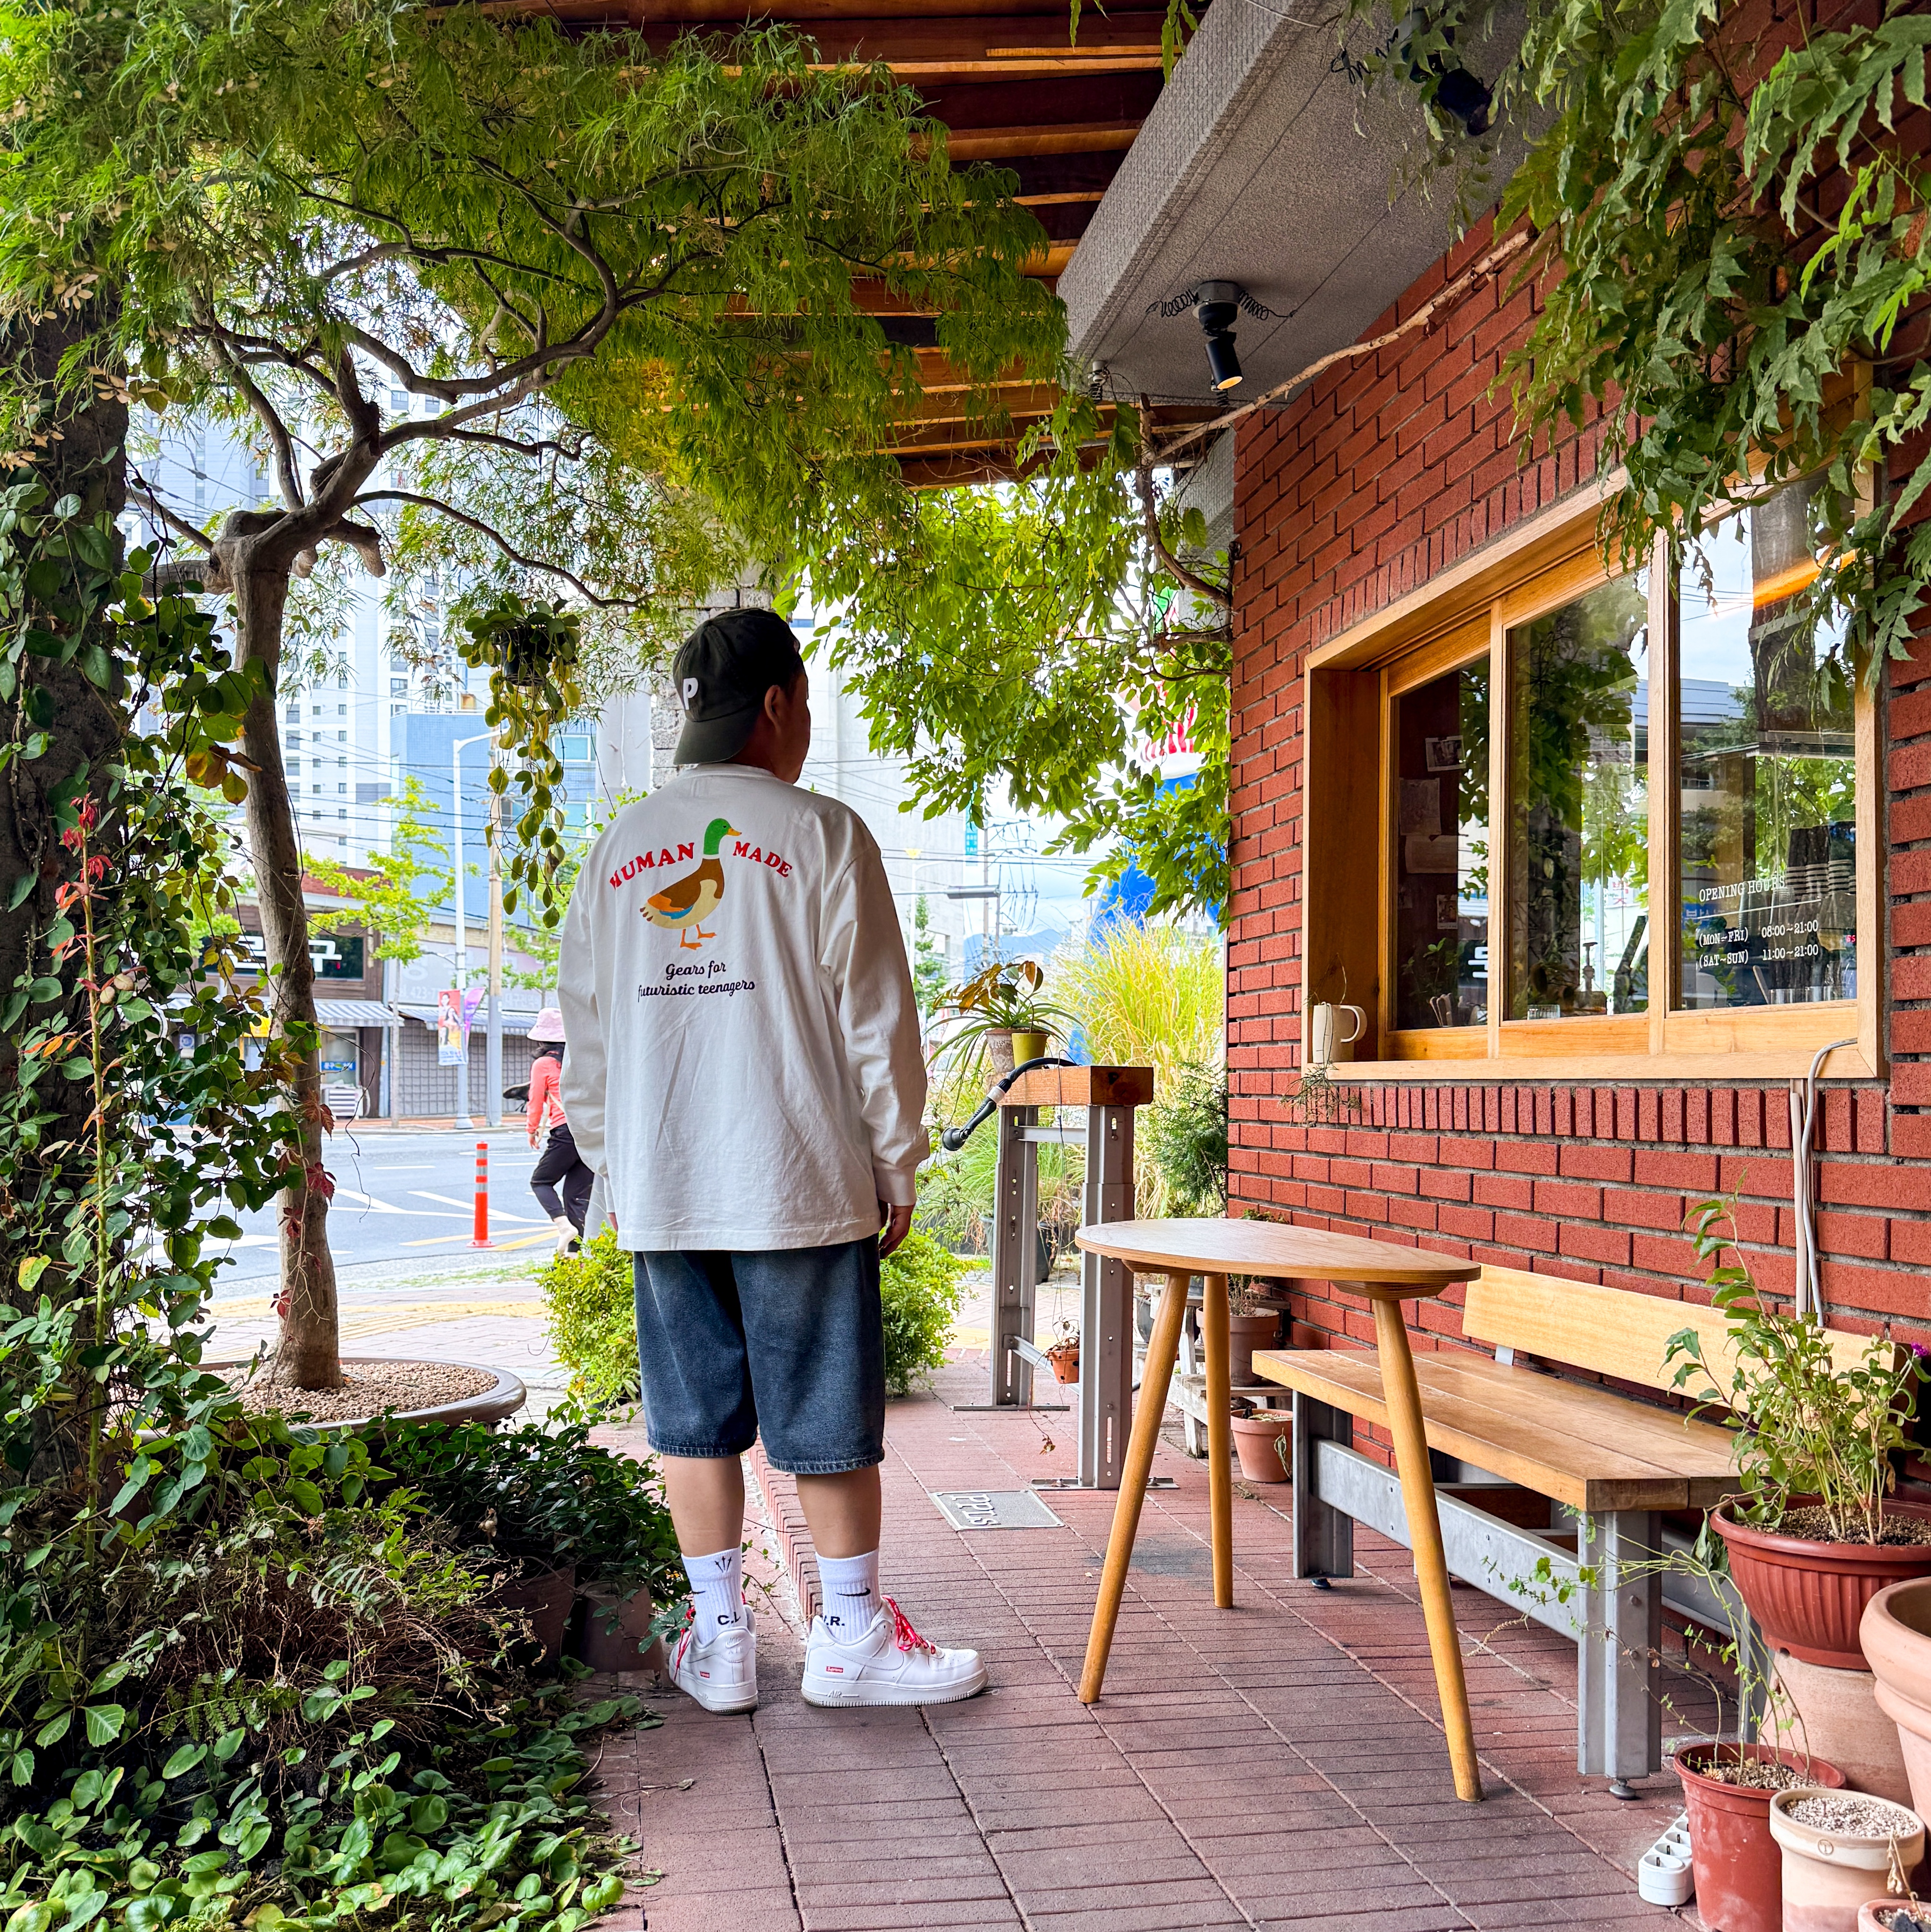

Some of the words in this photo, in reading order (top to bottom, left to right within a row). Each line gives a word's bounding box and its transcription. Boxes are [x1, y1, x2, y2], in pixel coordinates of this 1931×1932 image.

[683, 677, 698, 710] P
[609, 842, 695, 890] HUMAN
[732, 841, 793, 878] MADE
[1699, 880, 1745, 903] OPENING
[1747, 876, 1786, 895] HOURS
[666, 963, 705, 981] Gears
[708, 960, 727, 979] for
[638, 984, 695, 1003] futuristic
[698, 979, 756, 997] teenagers
[827, 1689, 842, 1699] AIR
